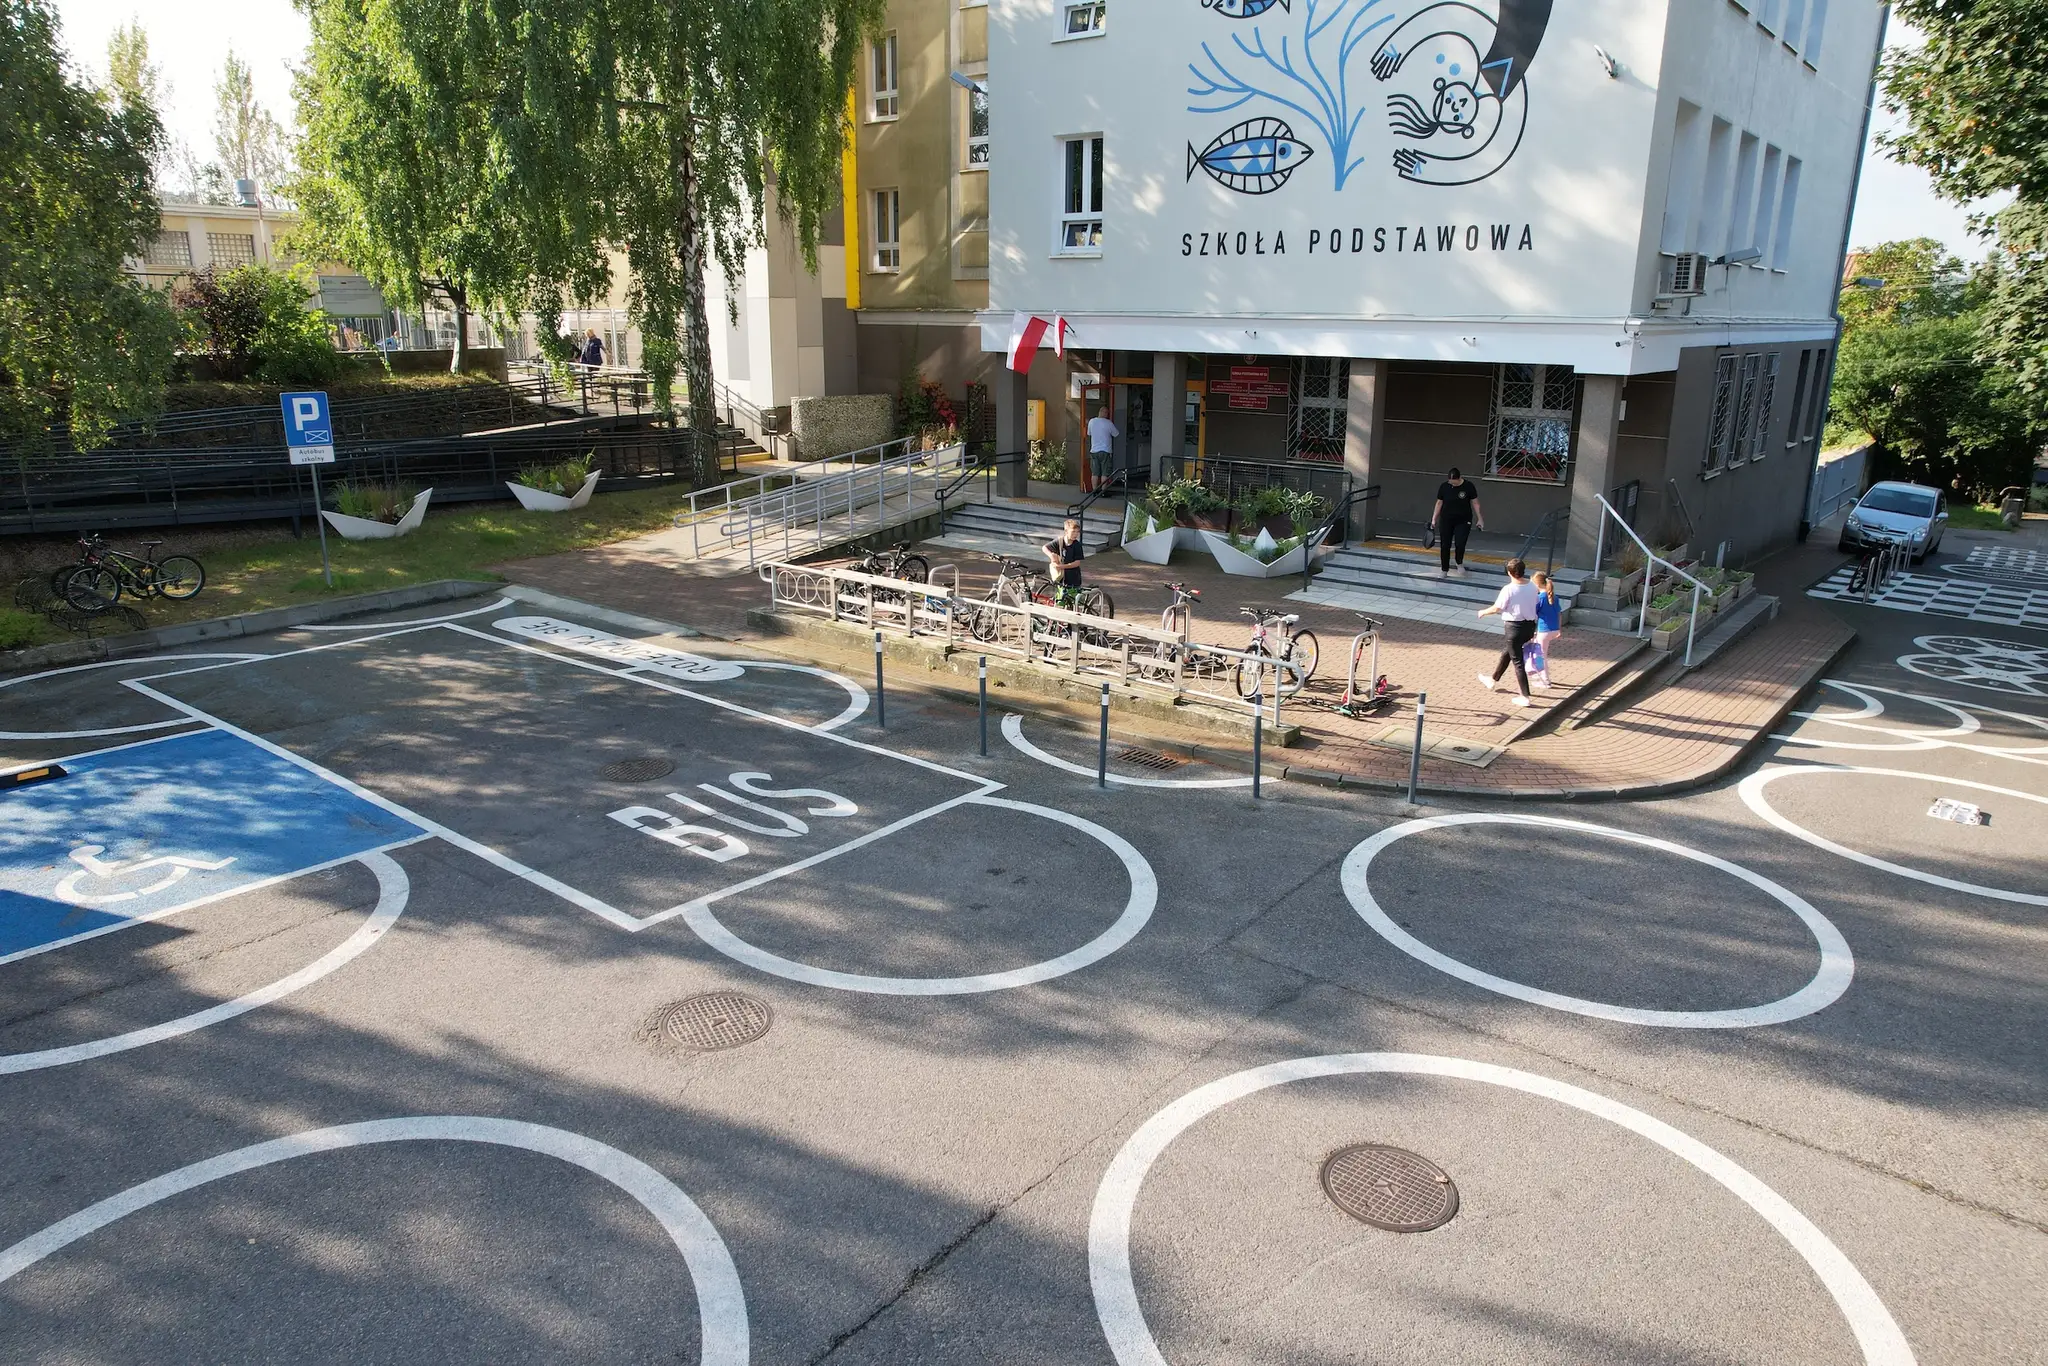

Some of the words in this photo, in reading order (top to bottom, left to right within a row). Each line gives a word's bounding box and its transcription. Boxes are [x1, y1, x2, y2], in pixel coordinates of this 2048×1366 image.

[1181, 230, 1286, 256] SZKOŁA
[1308, 223, 1533, 254] PODSTAWOWA
[292, 397, 320, 431] P
[605, 771, 859, 863] BUS
